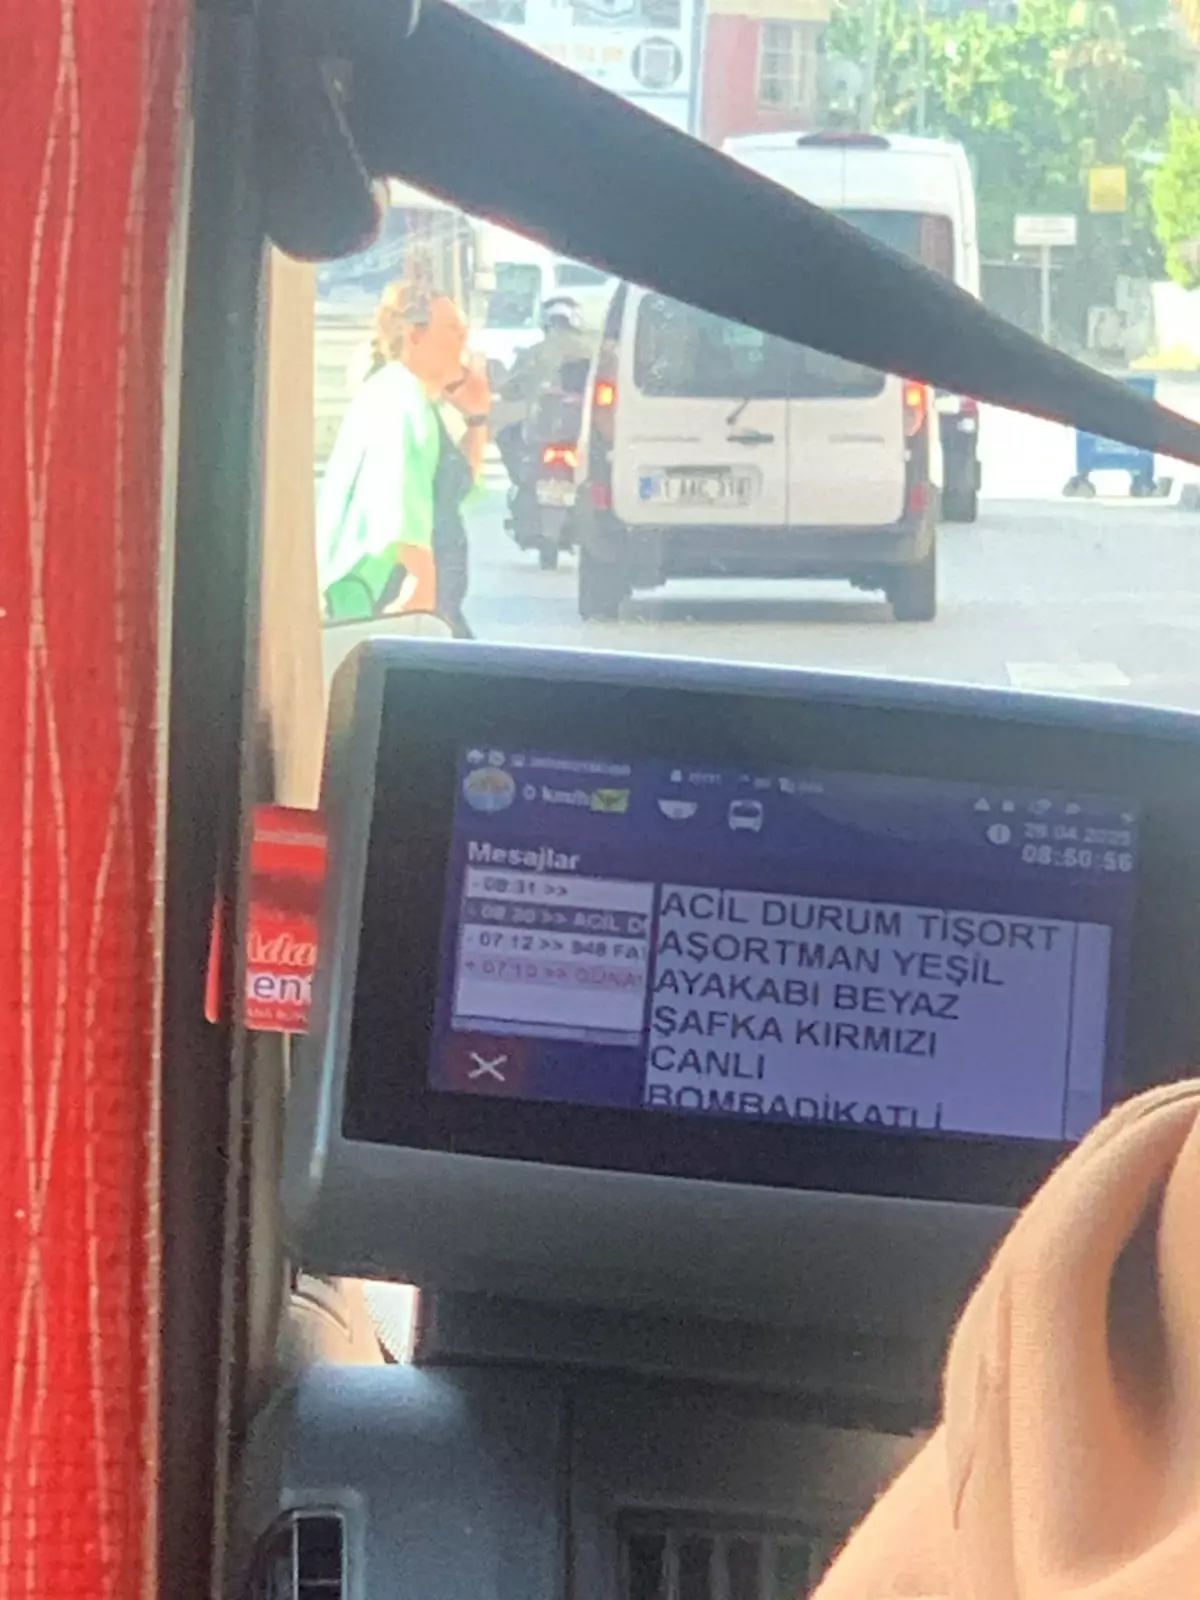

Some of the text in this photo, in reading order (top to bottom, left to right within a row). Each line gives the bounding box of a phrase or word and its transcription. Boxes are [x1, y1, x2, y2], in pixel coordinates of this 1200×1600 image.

[466, 840, 581, 872] Mesajlar
[660, 887, 1060, 952] ACİL DURUM TİŞORT
[657, 929, 1005, 988] AŞORTMAN YEŞİL
[653, 967, 960, 1020] AYAKABI BEYAZ
[653, 1005, 937, 1058] ŞAFKA KIRMIZI
[651, 1045, 765, 1080] CANLI
